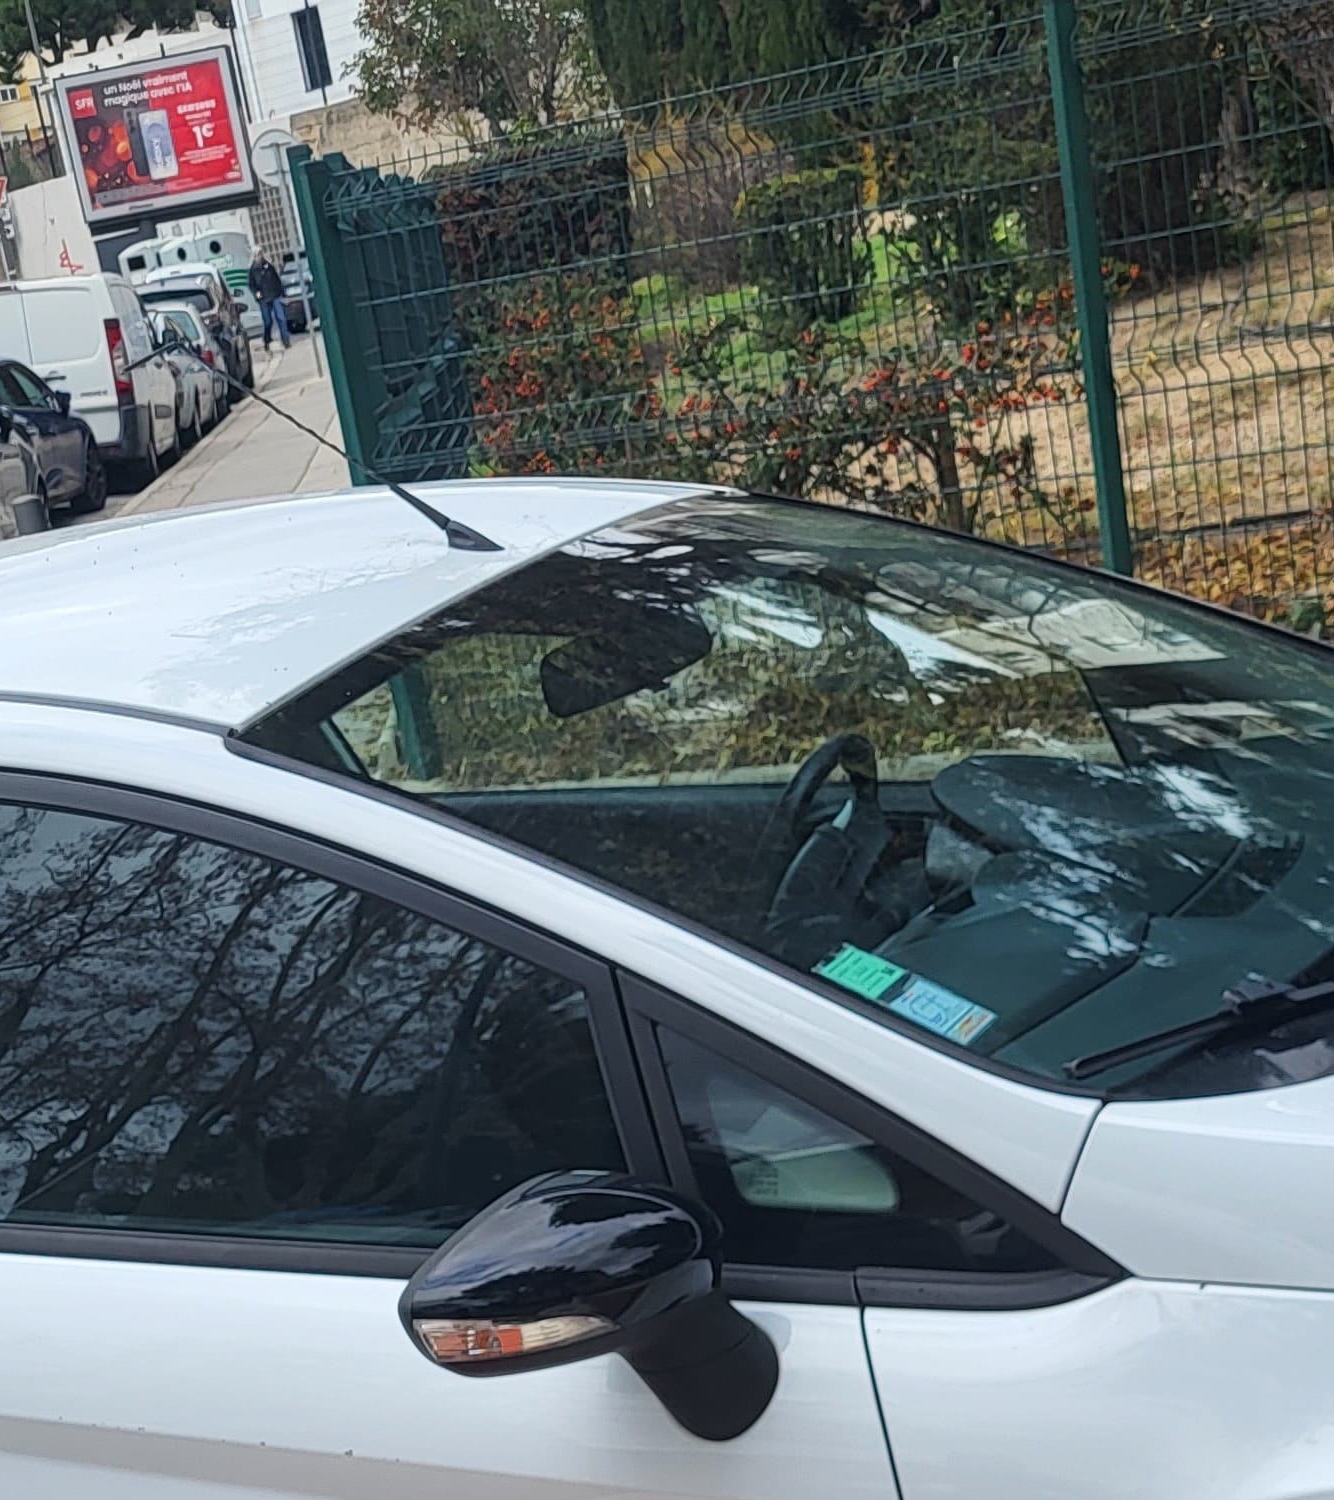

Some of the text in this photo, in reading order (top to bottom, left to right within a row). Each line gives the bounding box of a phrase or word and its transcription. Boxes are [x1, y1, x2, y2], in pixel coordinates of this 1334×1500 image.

[103, 85, 117, 95] un
[142, 70, 187, 88] vraiment
[74, 96, 94, 110] SFR
[104, 91, 149, 107] magique
[150, 86, 175, 98] avec
